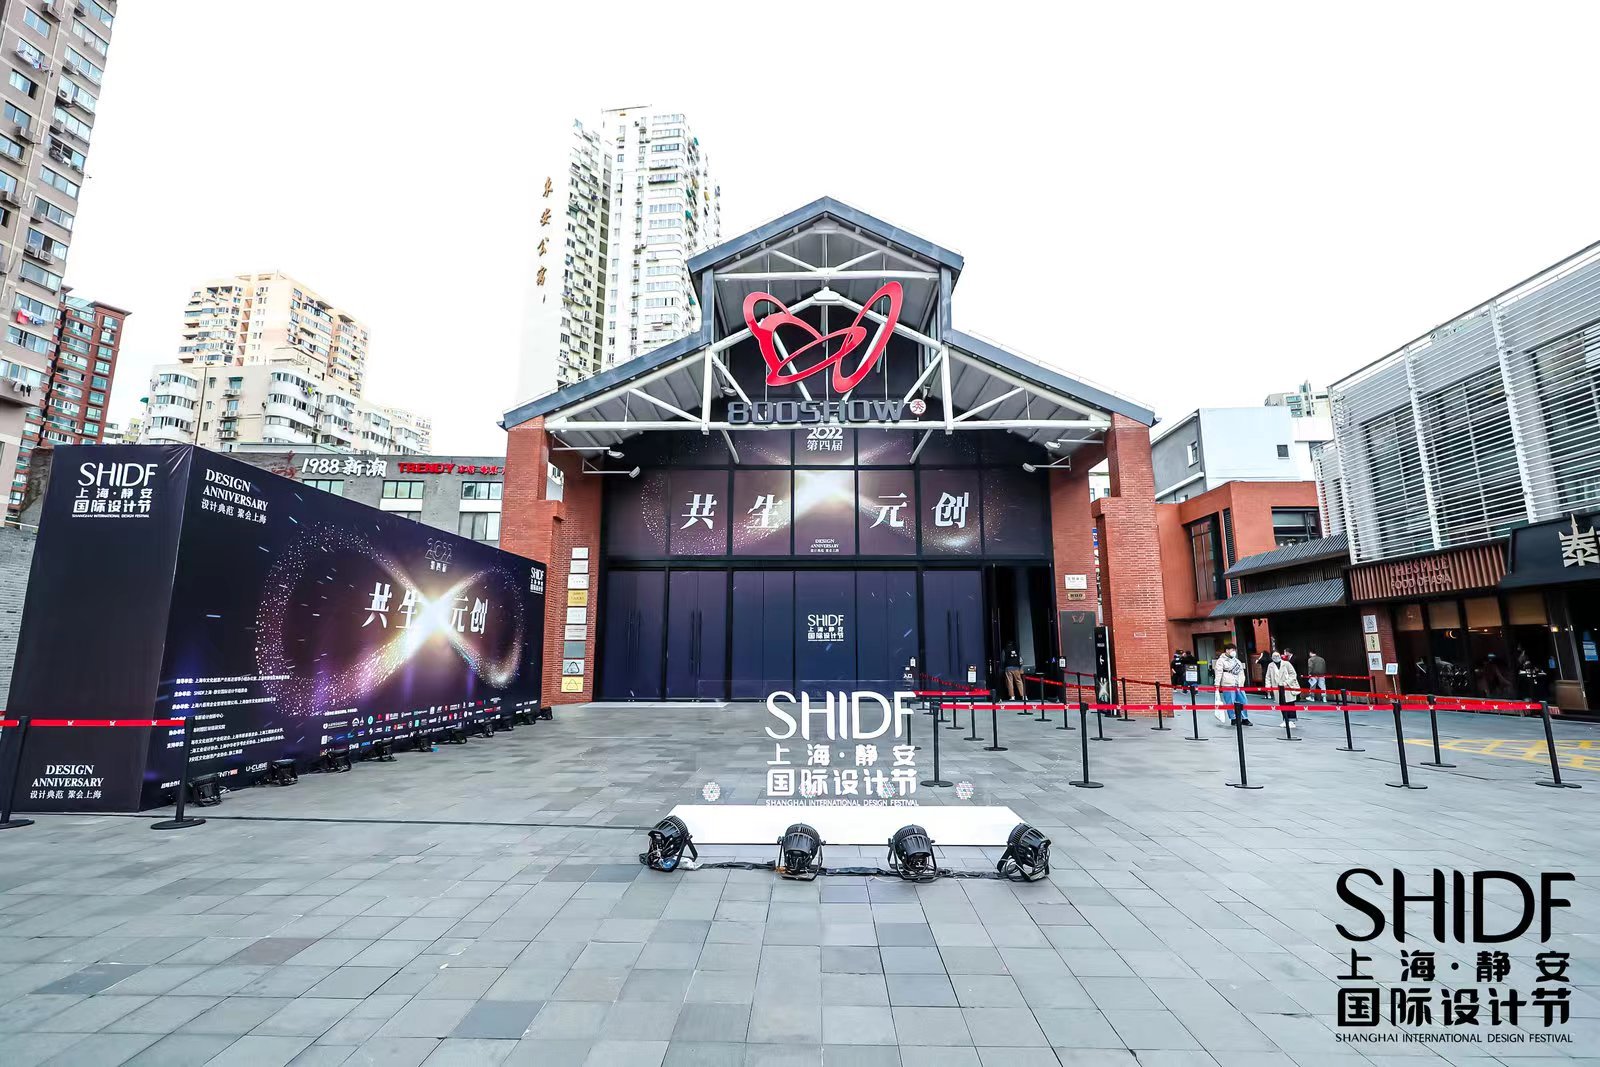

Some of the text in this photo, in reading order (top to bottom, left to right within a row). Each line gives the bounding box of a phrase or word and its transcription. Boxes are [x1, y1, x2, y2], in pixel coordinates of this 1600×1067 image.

[727, 399, 905, 425] 800SHOW
[912, 399, 925, 414] 秀
[806, 427, 843, 439] 2022
[806, 440, 843, 451] 第四届
[77, 462, 158, 487] SHIDF
[301, 457, 339, 475] 1988
[342, 456, 388, 478] 新潮
[397, 462, 456, 475] TRENDY
[205, 468, 251, 492] DESIGN
[203, 485, 269, 512] ANNIVERSARY
[73, 500, 152, 513] 国际设计节
[201, 498, 234, 517] 设计典范
[1558, 513, 1600, 568] 泰
[807, 614, 844, 627] SHIDF
[765, 690, 917, 741] SHIDF
[45, 764, 95, 775] DESIGN
[31, 777, 104, 787] ANNIVERSARY
[766, 768, 917, 797] 国际设计节
[29, 790, 64, 799] 设计典范
[766, 799, 920, 807] SHANGHAI INTERNATIONAL DESIGN FESTIVAL
